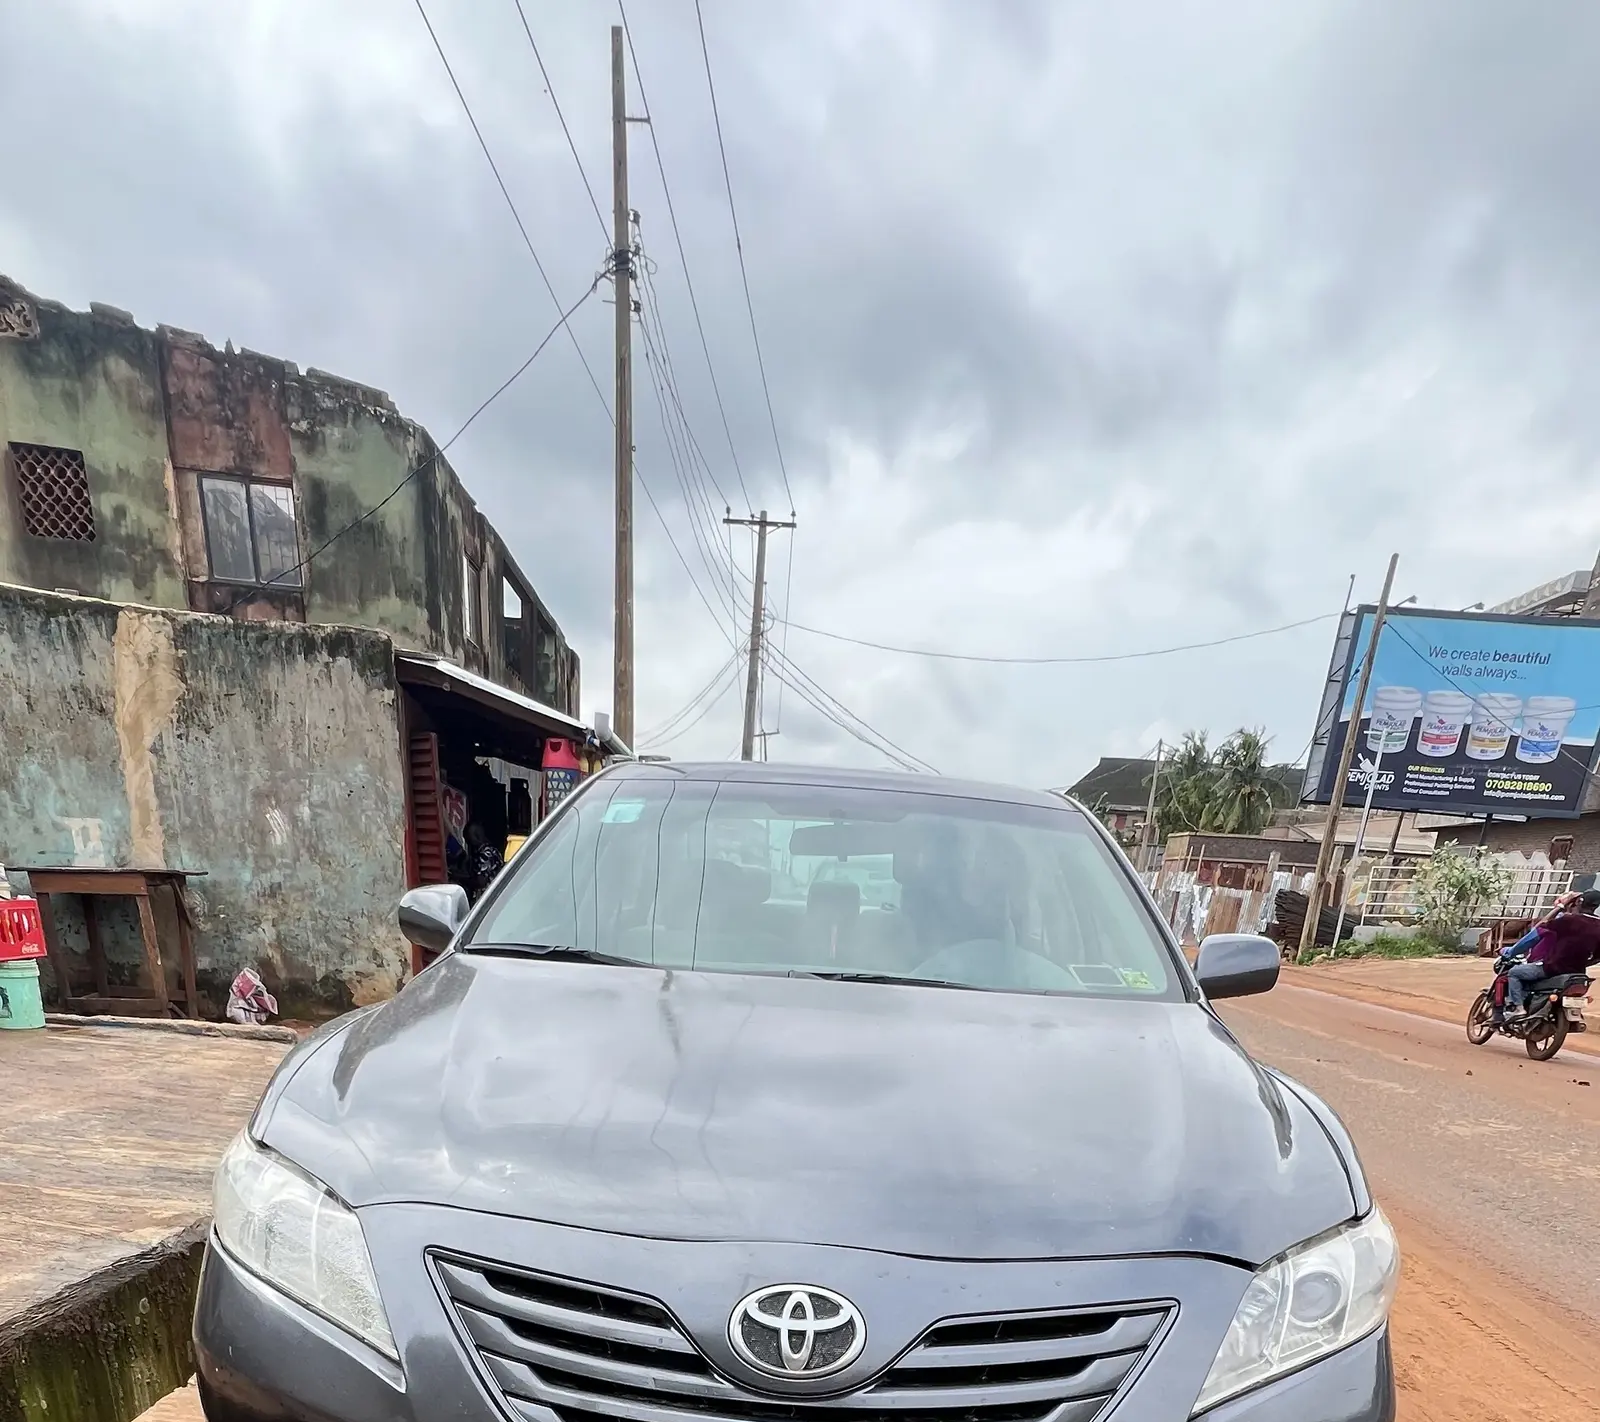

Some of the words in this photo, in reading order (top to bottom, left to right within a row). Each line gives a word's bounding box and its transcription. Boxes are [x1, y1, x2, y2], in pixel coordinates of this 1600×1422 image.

[1428, 645, 1448, 659] We
[1450, 649, 1490, 661] create
[1492, 650, 1551, 665] beautiful
[1441, 664, 1472, 677] walls
[1474, 666, 1527, 681] always...
